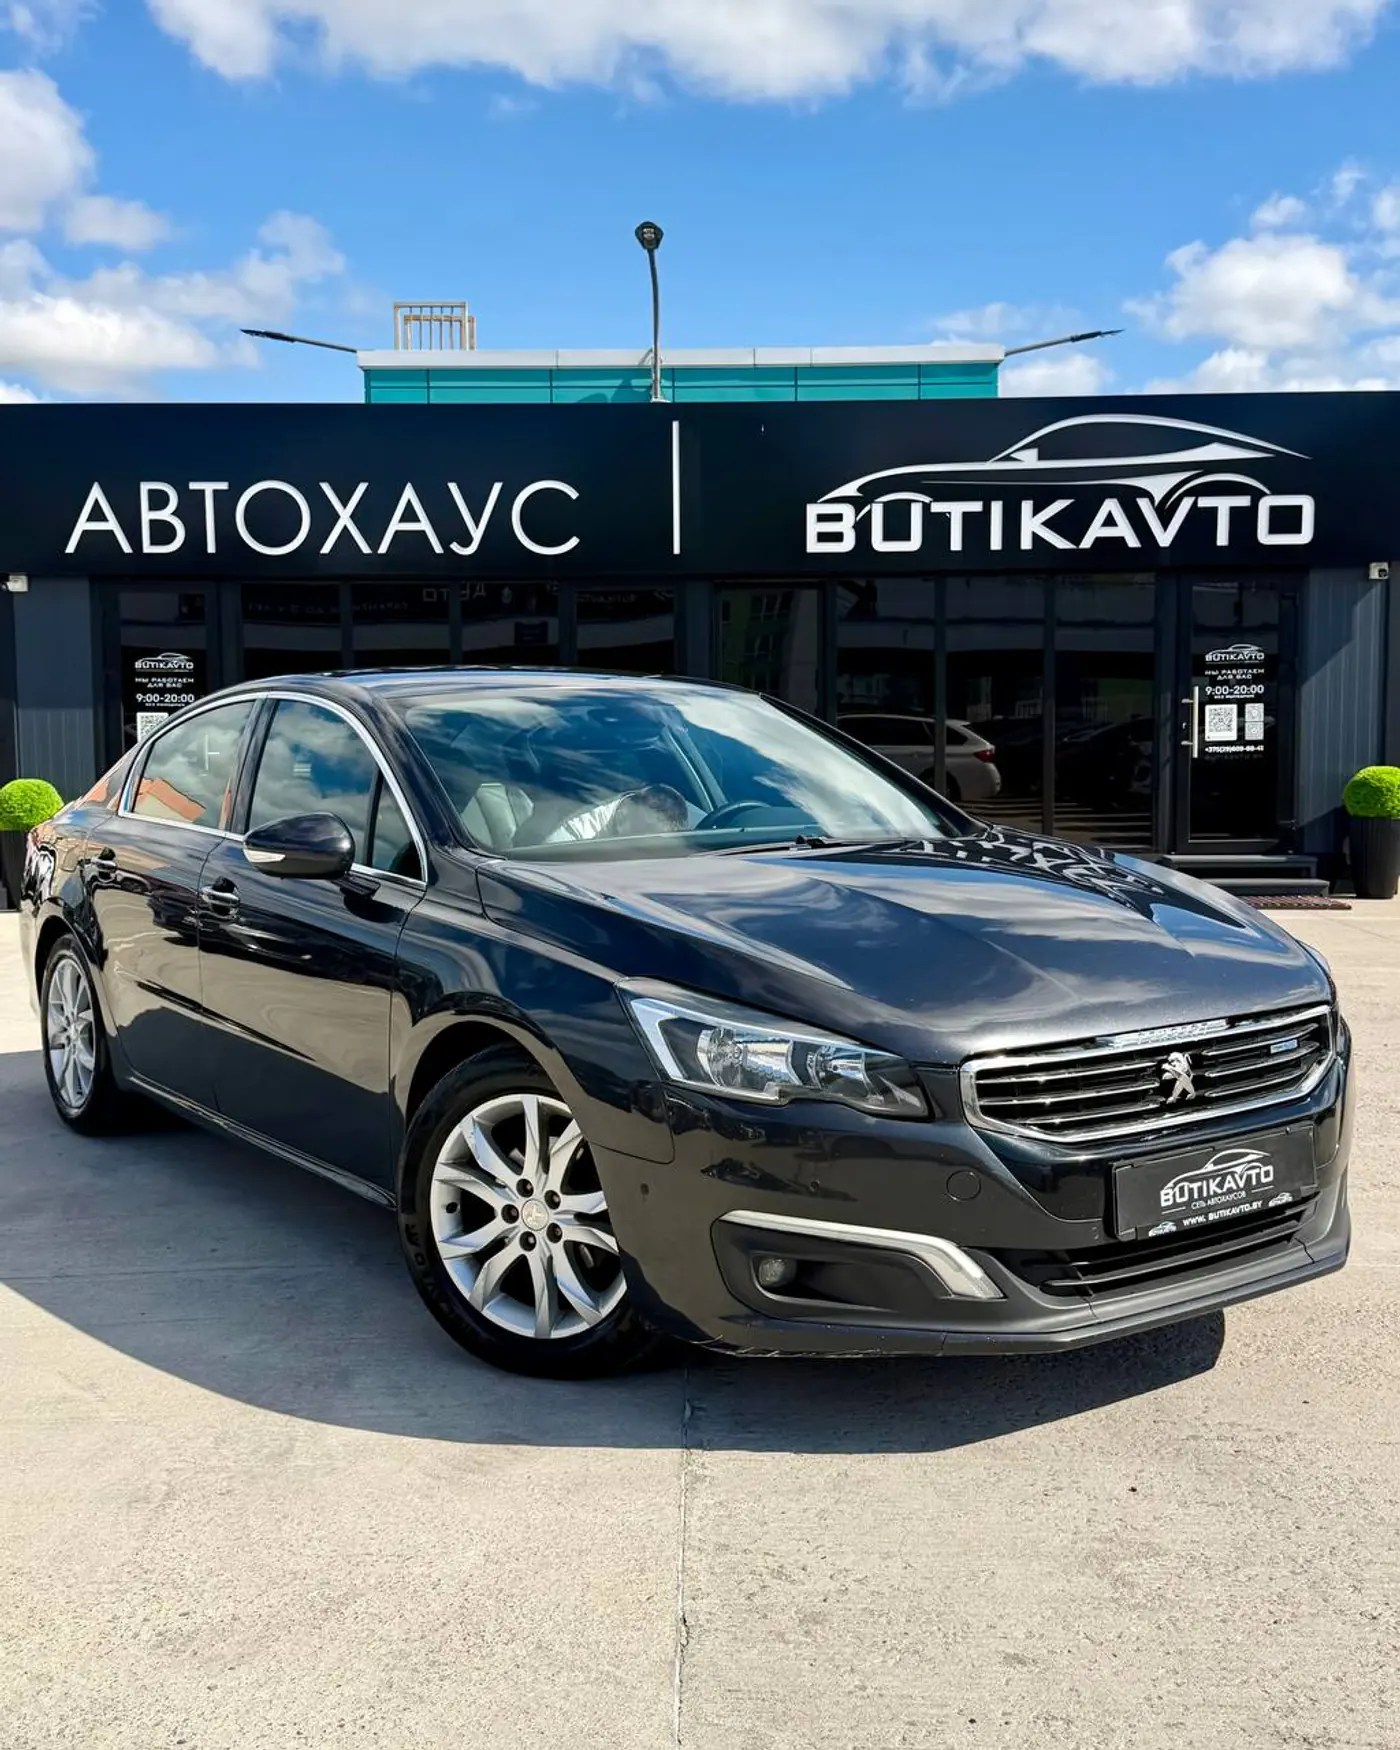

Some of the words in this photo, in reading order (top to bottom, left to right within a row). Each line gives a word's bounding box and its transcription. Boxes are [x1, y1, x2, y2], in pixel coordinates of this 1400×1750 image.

[65, 480, 580, 556] АВТОХАУС
[806, 494, 1315, 553] BUTIKAVTO
[1205, 652, 1264, 661] BUTIKAVTO
[135, 661, 194, 669] BUTIKAVTO
[1205, 684, 1265, 696] 9:00-20:00
[136, 693, 195, 703] 9:00-20:00
[1160, 1165, 1274, 1207] BUTIKAVTO
